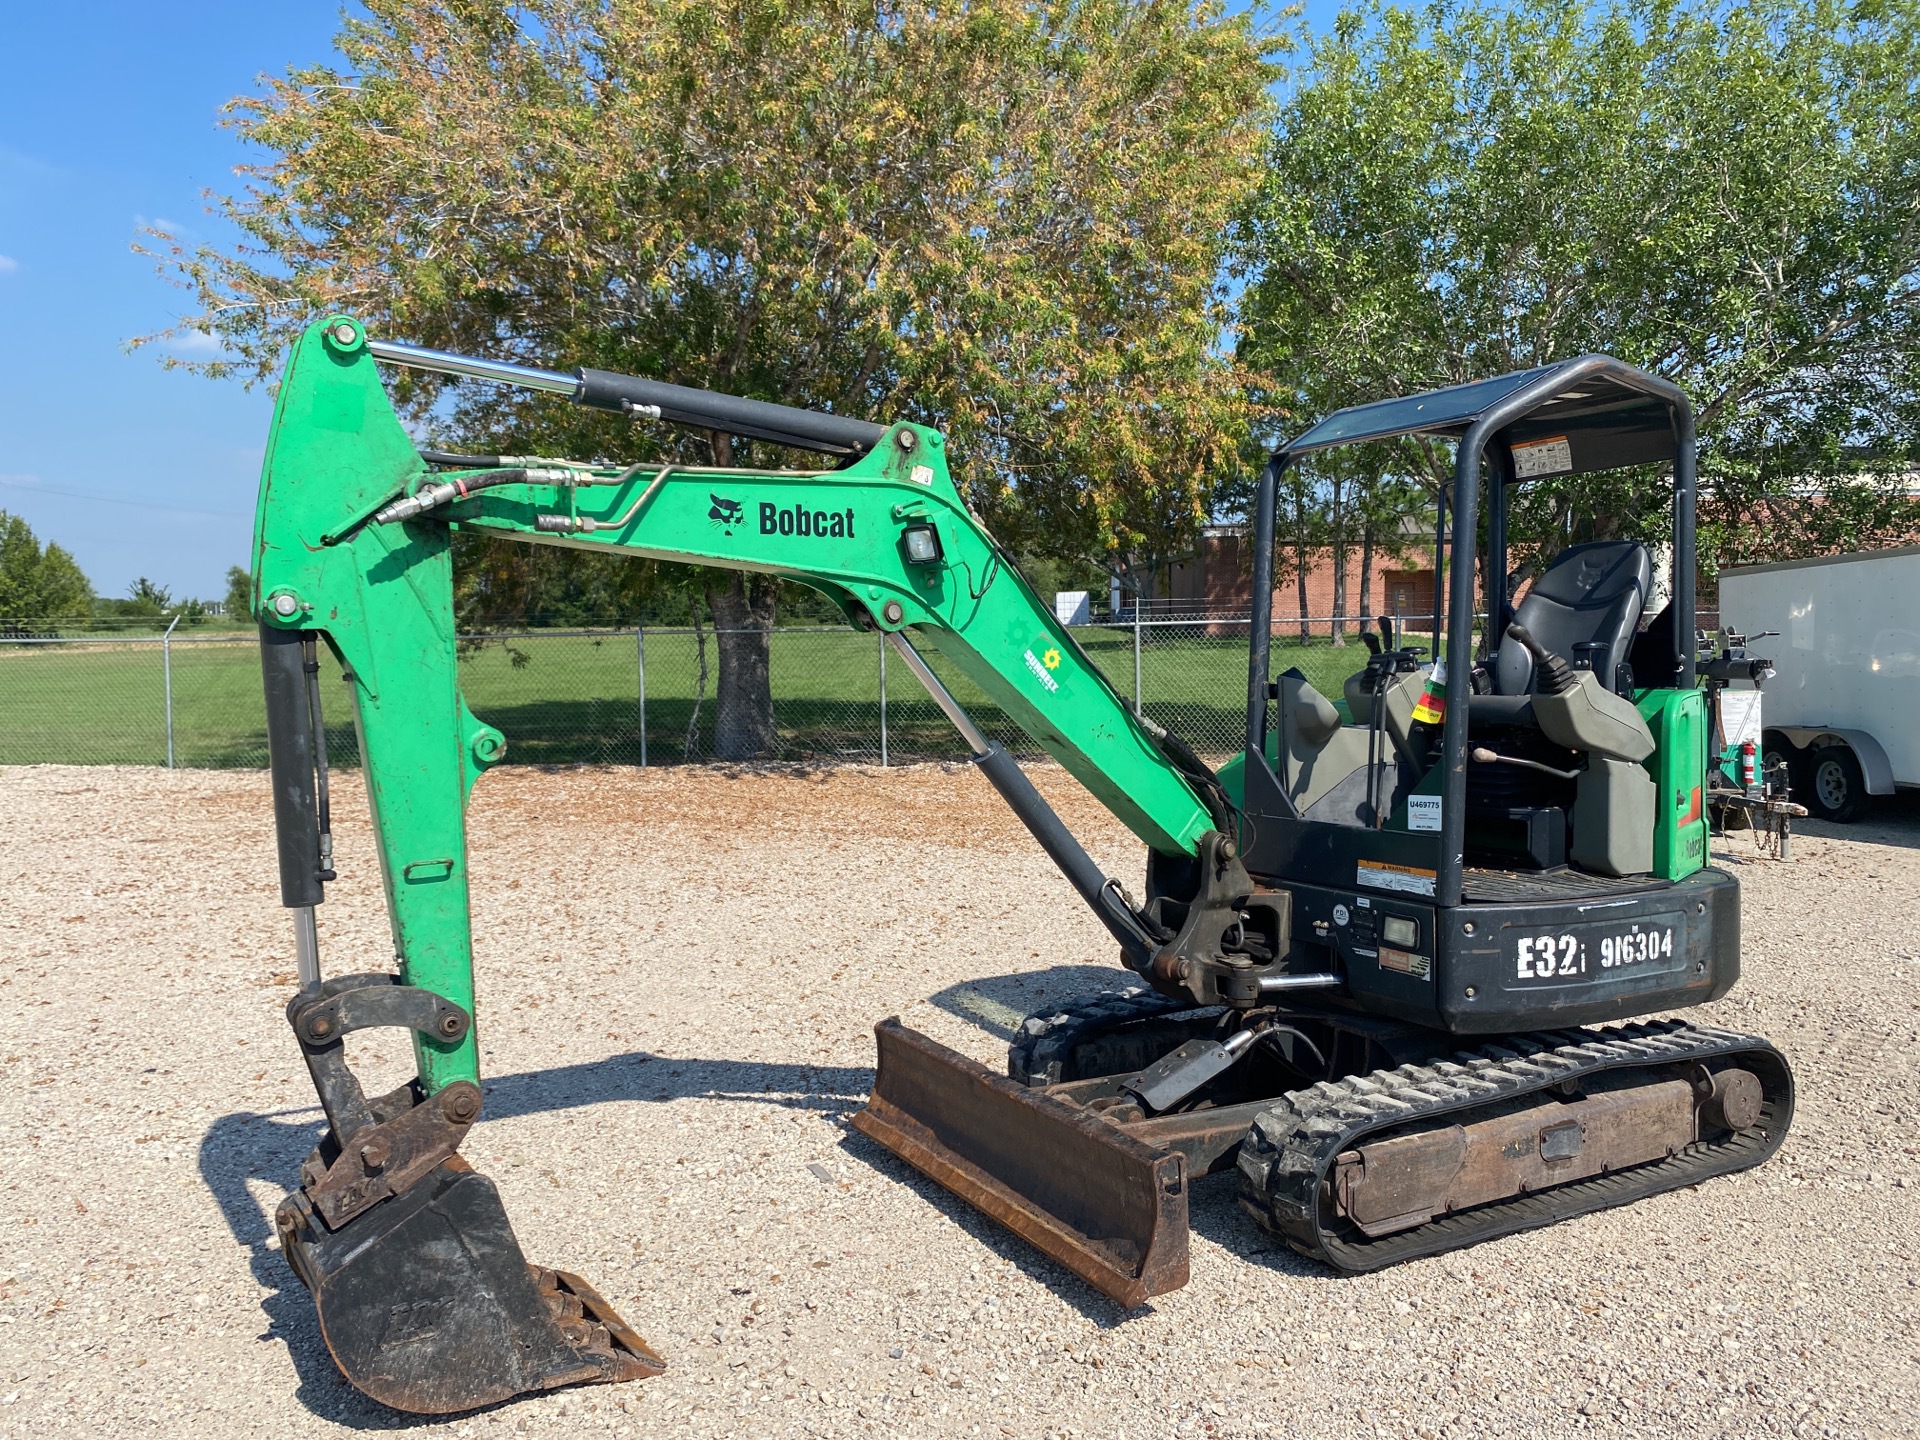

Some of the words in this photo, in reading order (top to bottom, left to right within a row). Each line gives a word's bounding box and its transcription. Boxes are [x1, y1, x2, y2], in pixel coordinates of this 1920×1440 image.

[759, 502, 855, 538] Bobcat
[1023, 649, 1059, 693] SUNBELT
[1025, 661, 1049, 691] RENTALS
[1410, 801, 1440, 809] U469775
[1517, 934, 1586, 979] E32i
